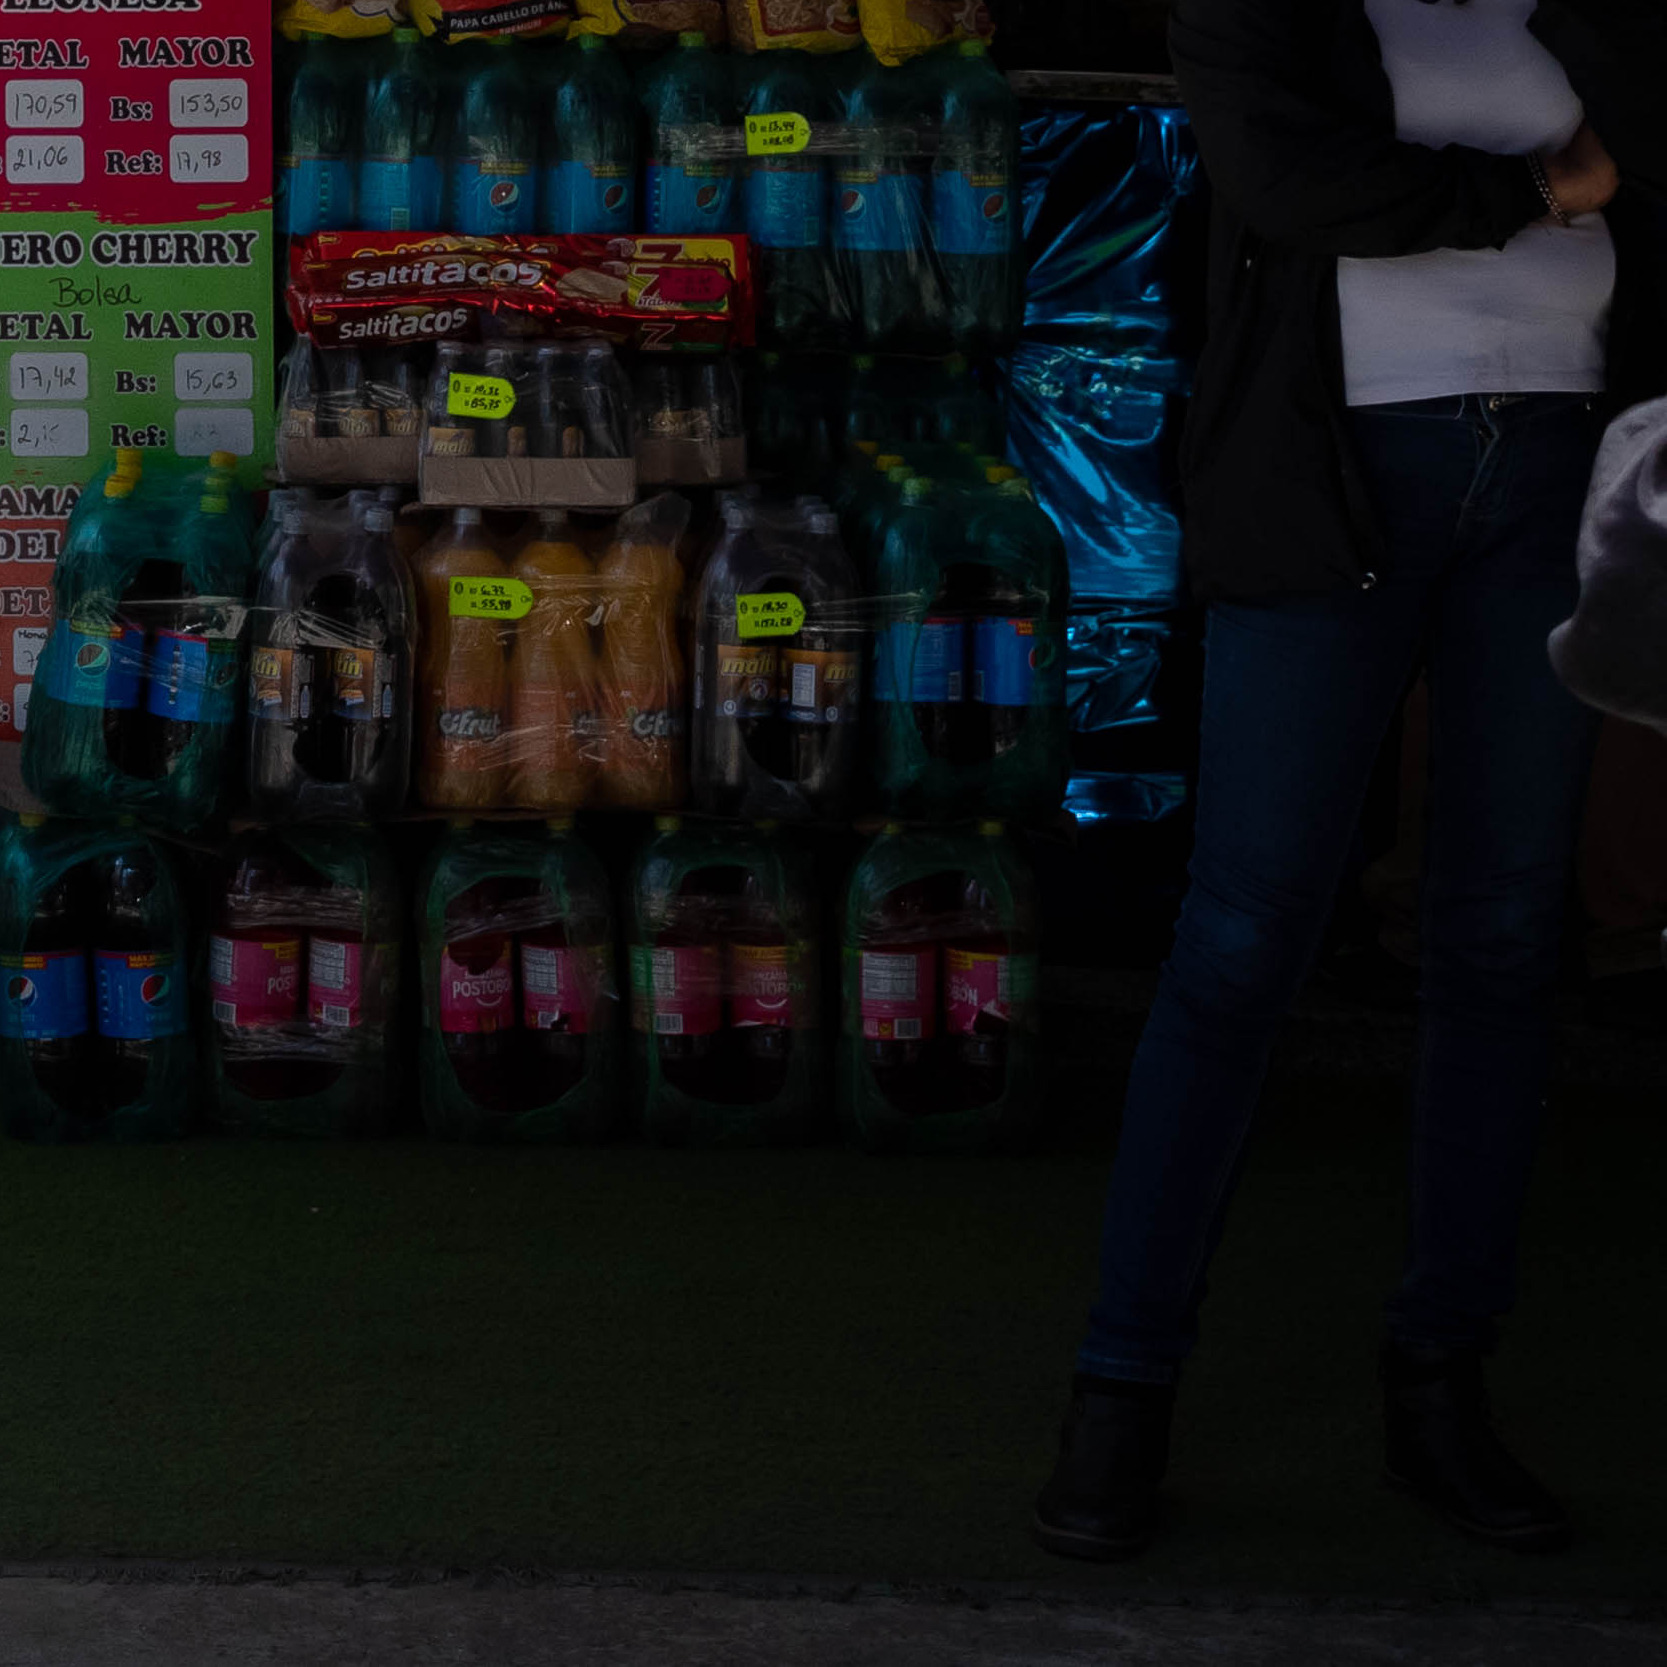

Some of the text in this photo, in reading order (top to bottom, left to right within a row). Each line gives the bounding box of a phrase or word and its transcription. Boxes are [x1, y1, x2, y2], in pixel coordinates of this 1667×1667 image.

[450, 13, 479, 29] PAPA
[481, 7, 529, 27] CABELLO
[531, 3, 545, 16] DE
[90, 233, 258, 269] CHERRY
